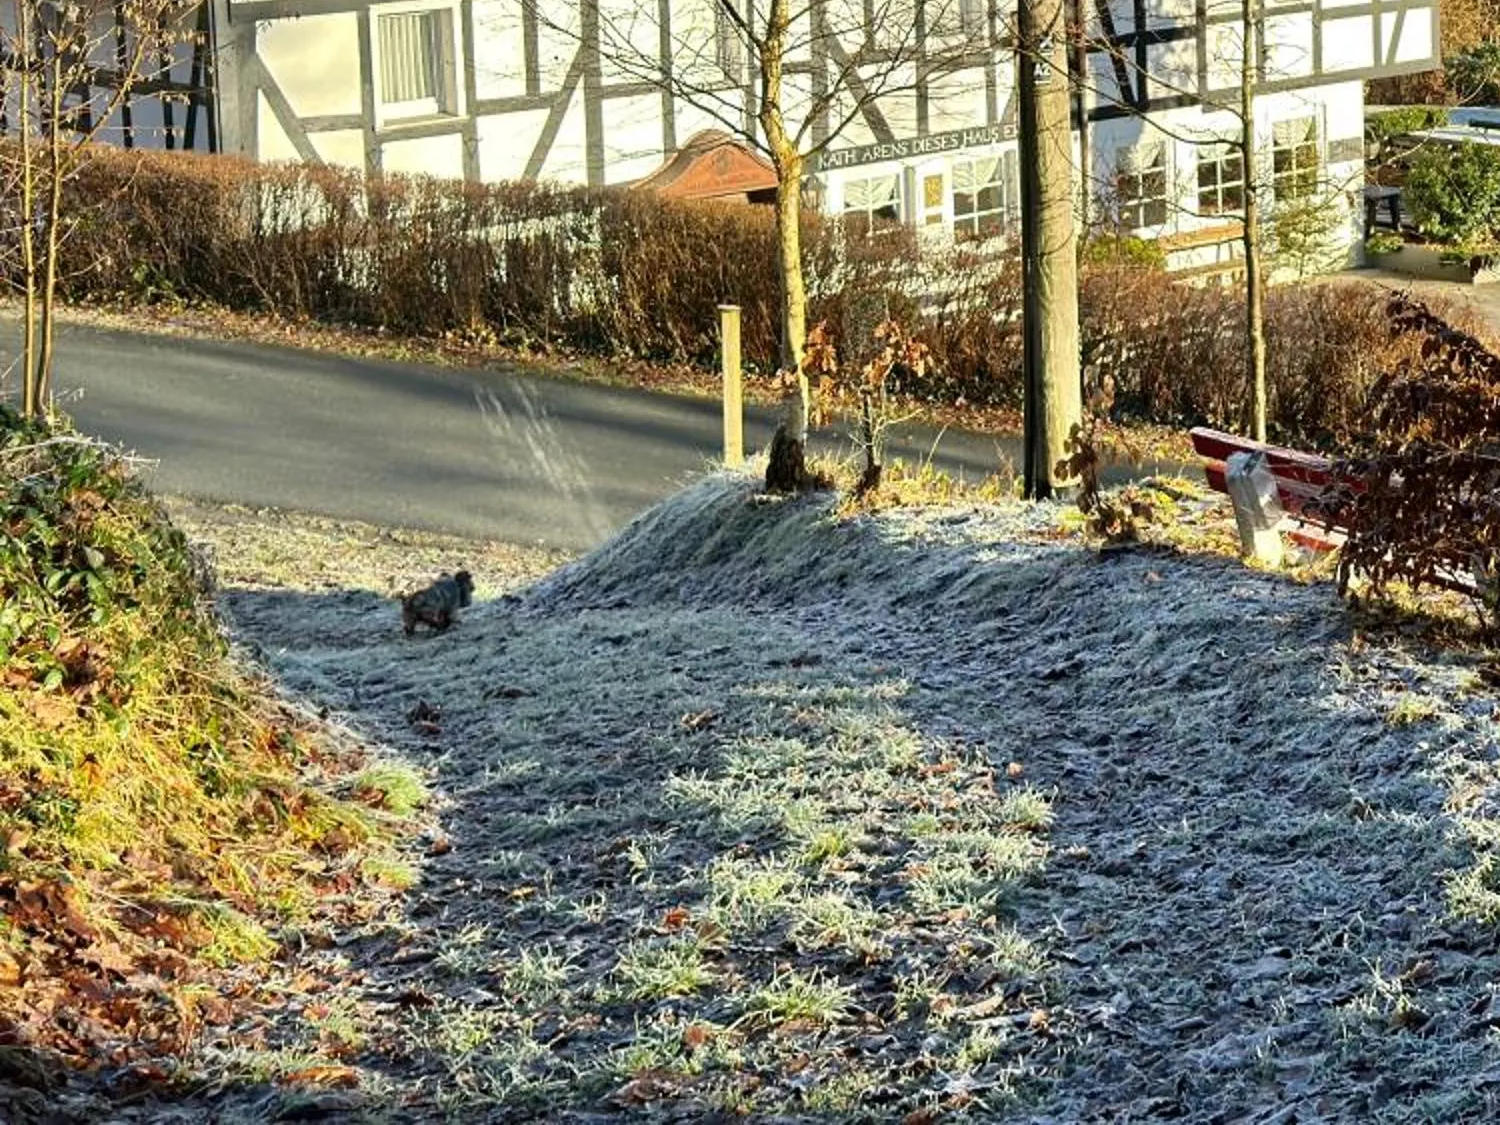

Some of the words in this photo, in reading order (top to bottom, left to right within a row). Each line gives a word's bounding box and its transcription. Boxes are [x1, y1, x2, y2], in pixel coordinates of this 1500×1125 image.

[818, 149, 856, 169] KATH
[862, 141, 908, 161] ARENS
[912, 133, 958, 153] DIESES
[963, 126, 999, 144] HAUS
